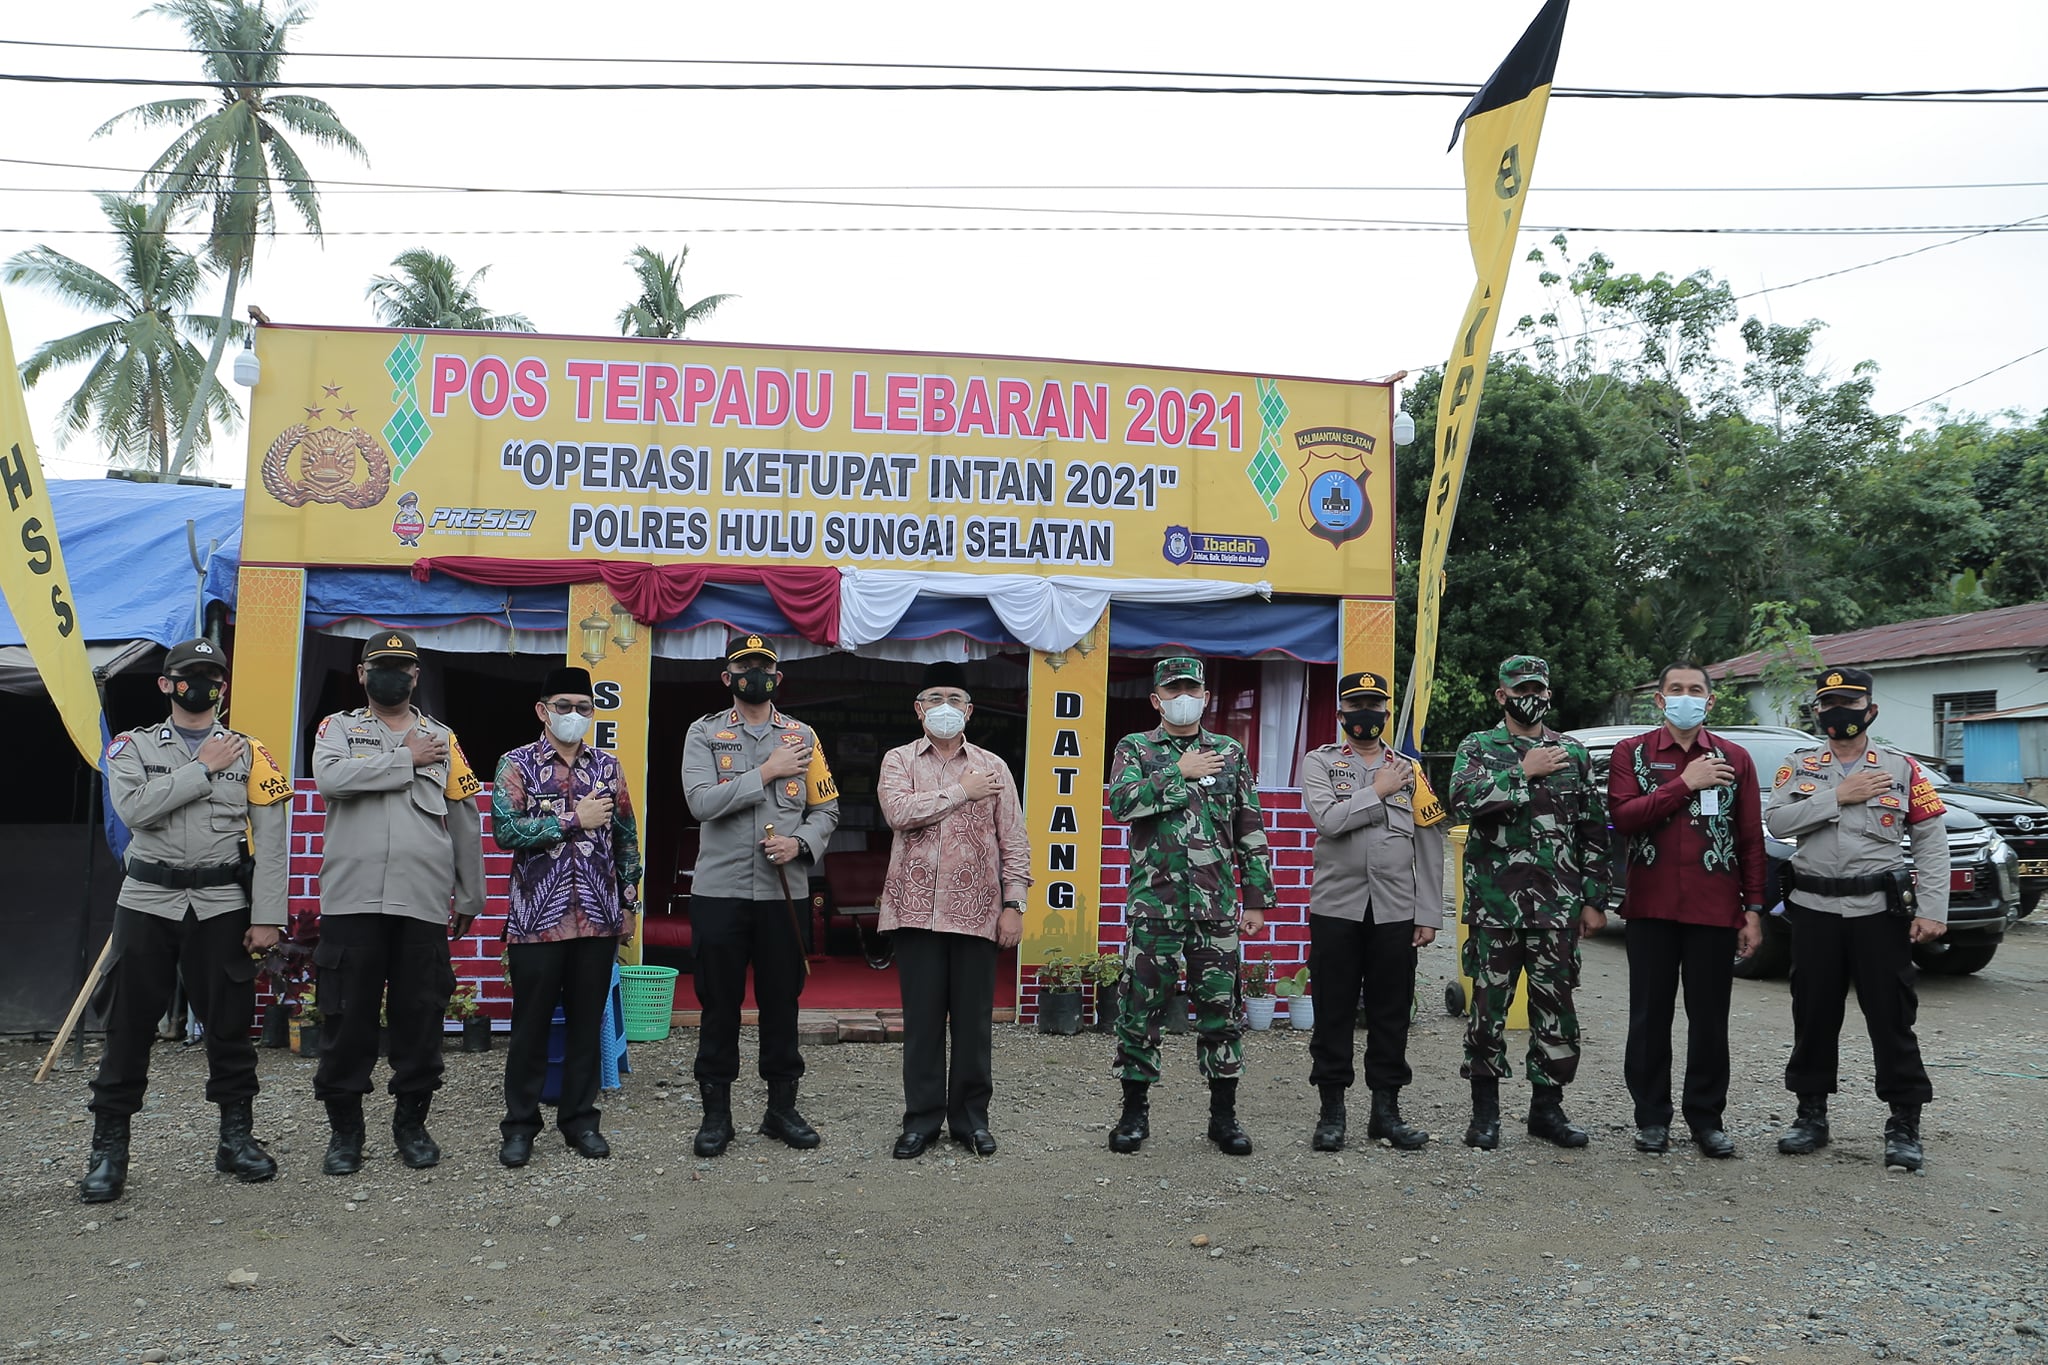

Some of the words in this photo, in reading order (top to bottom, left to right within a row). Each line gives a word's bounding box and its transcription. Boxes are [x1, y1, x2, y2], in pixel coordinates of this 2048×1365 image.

[433, 357, 547, 417] POS
[567, 362, 831, 429] TERPADU
[854, 375, 1106, 439] LEBARAN
[1127, 389, 1239, 449] 2021
[1298, 432, 1342, 446] KALIMANTAN
[1342, 433, 1373, 450] SELATAN
[725, 451, 916, 497] KETUPAT
[930, 458, 1053, 502] INTAN
[428, 507, 537, 531] PRESISI
[573, 511, 708, 550] POLRES
[719, 513, 813, 554] HULU
[824, 516, 954, 556] SUNGAI
[965, 520, 1111, 562] SELATAN
[1203, 537, 1256, 553] Ibadah
[711, 742, 742, 752] SISWOYO
[1329, 769, 1356, 780] DIDIK
[269, 783, 290, 798] POS
[461, 780, 480, 794] POS
[1047, 692, 1081, 910] DATANG
